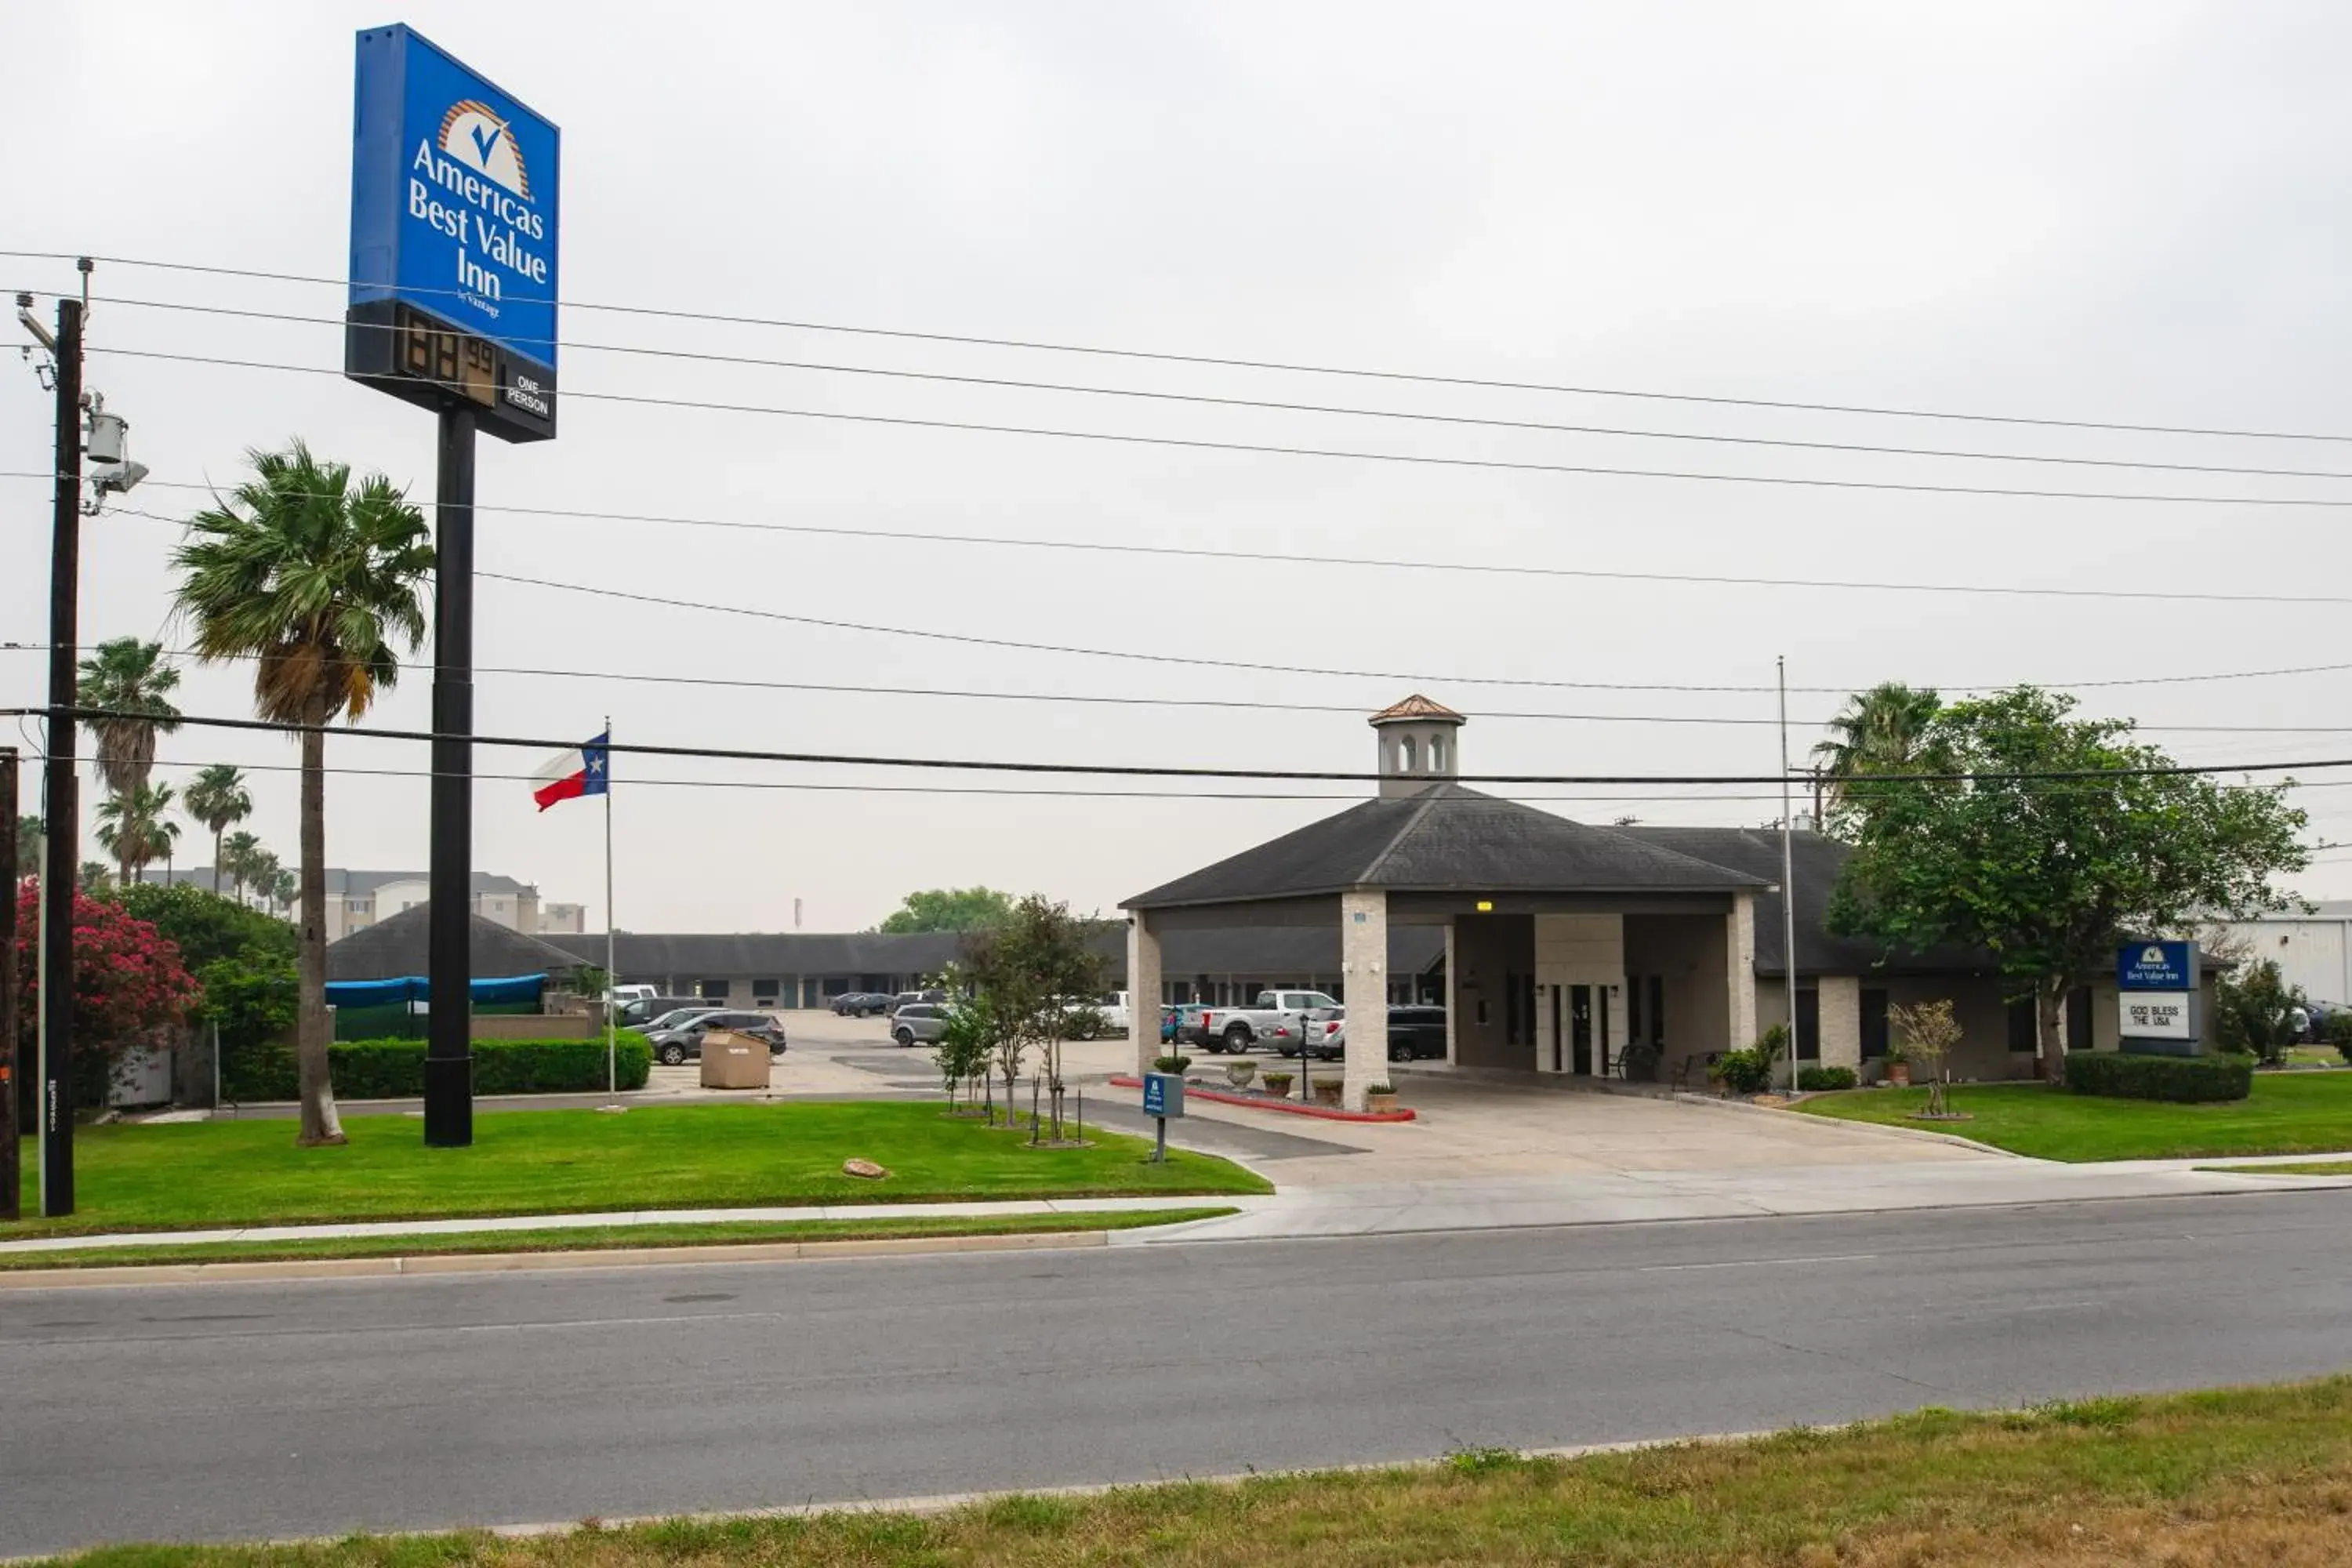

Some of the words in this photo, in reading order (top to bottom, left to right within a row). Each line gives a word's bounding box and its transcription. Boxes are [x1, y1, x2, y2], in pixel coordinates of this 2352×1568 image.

[414, 138, 543, 240] Americas
[409, 177, 468, 244] Best
[476, 215, 546, 284] Value
[459, 247, 500, 301] Inn
[517, 376, 539, 394] ONE
[507, 388, 548, 415] PERSON
[2135, 961, 2170, 971] Americas
[2127, 971, 2143, 980] Best
[2143, 971, 2165, 980] Value
[2165, 971, 2179, 980] Inn
[2151, 1006, 2179, 1017] BLESS
[2153, 1015, 2171, 1026] USA
